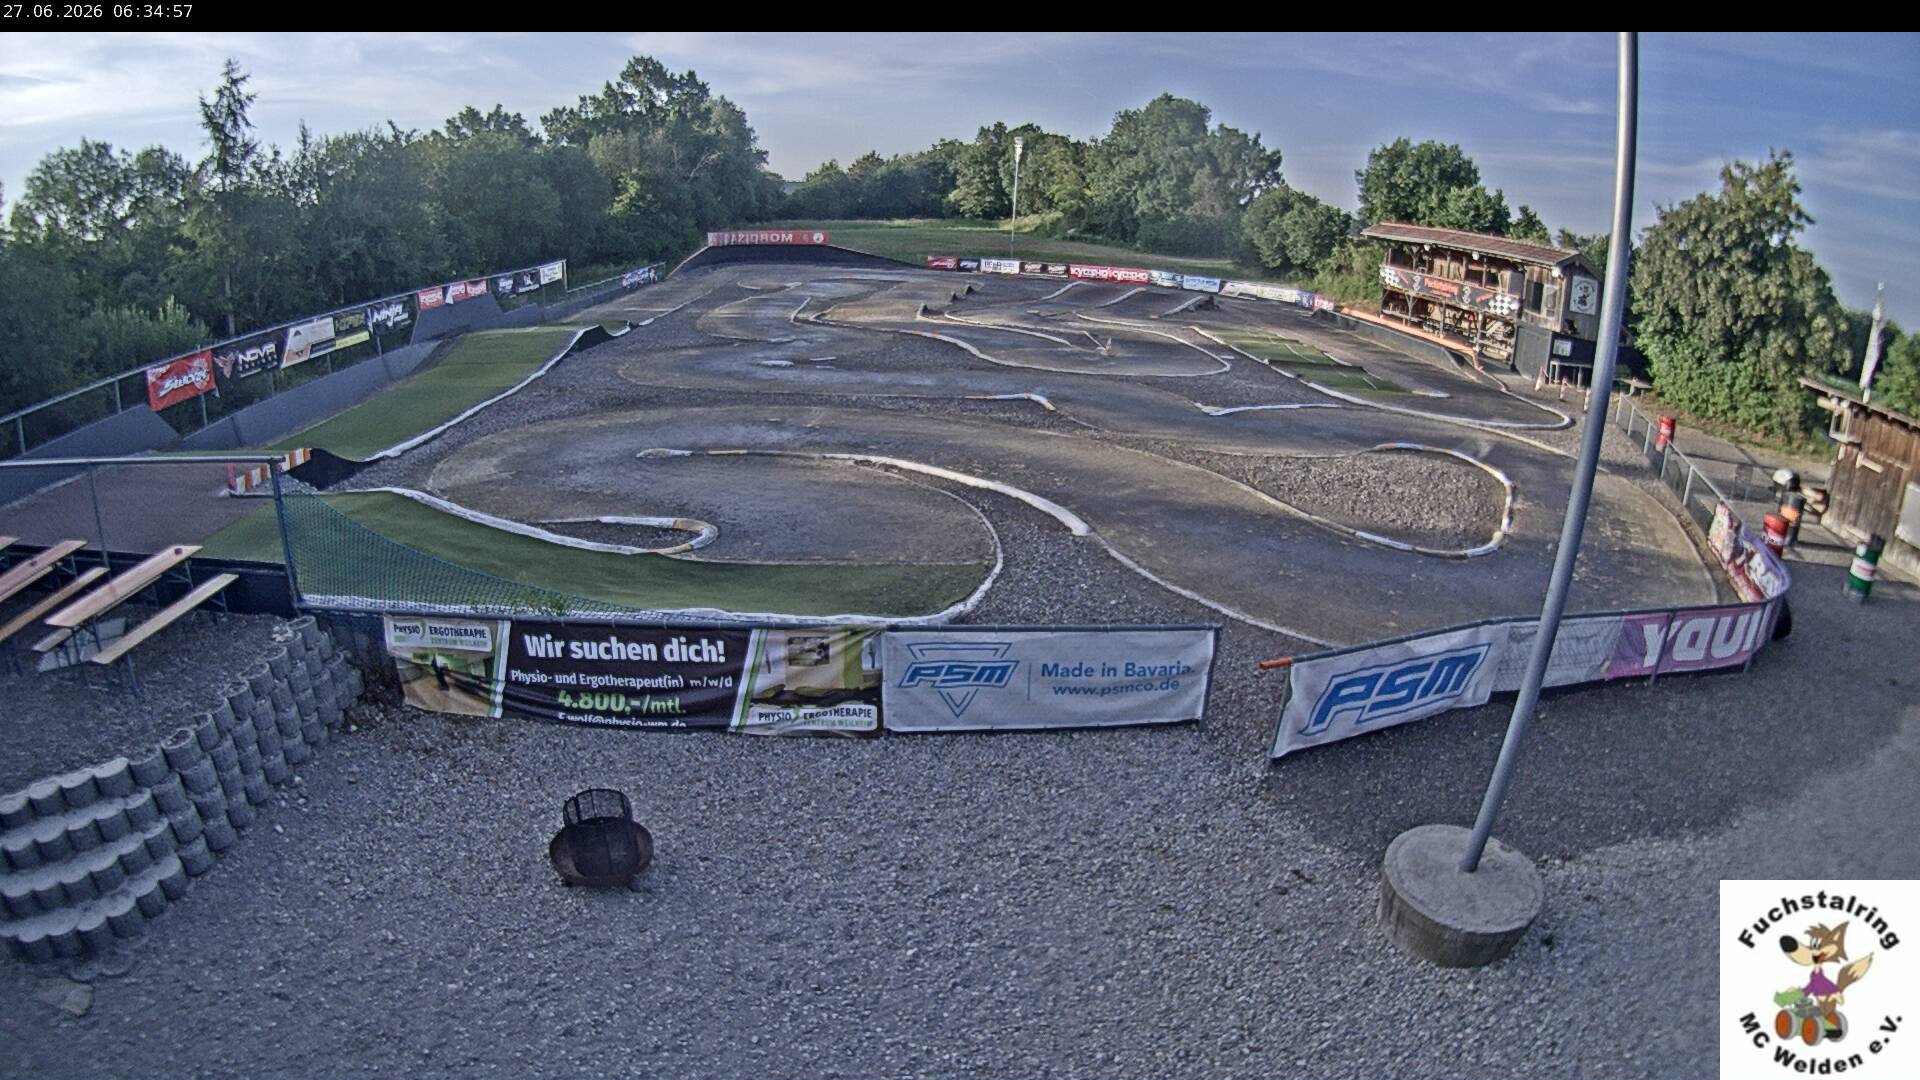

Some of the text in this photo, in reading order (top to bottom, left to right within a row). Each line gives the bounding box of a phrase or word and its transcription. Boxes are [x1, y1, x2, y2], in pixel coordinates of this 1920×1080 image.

[393, 624, 487, 639] PHYSIO ERGOTHERAPIE
[523, 633, 726, 663] Wir suchen dich!
[511, 669, 733, 690] Physio- und Ergotherapeut(in) m/w/d
[905, 663, 1011, 685] PSM
[1041, 662, 1095, 678] Made
[1102, 661, 1118, 678] in
[1053, 678, 1180, 697] www.psmco.de
[1311, 653, 1481, 730] PSM
[758, 707, 872, 721] PHYSIO ERGOTHERAPIE
